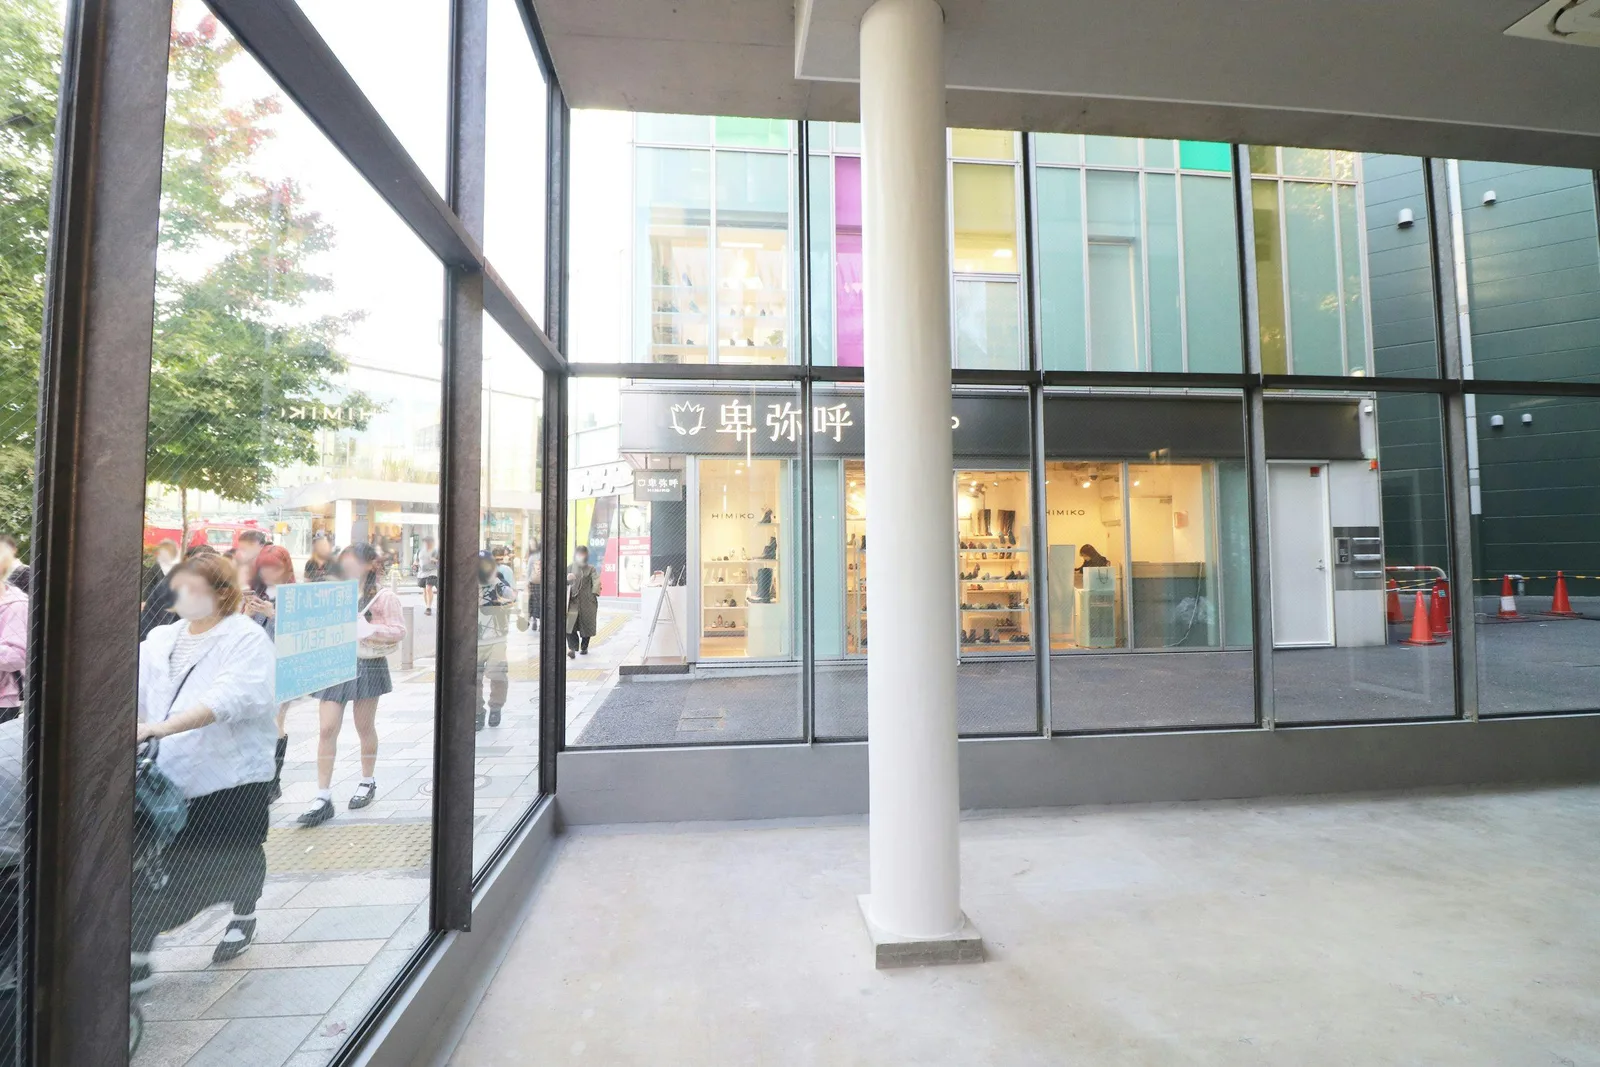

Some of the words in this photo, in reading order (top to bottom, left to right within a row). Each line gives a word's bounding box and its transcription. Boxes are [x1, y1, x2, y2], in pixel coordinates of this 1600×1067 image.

[716, 399, 853, 441] 卑弥呼
[647, 478, 679, 488] 卑弥呼
